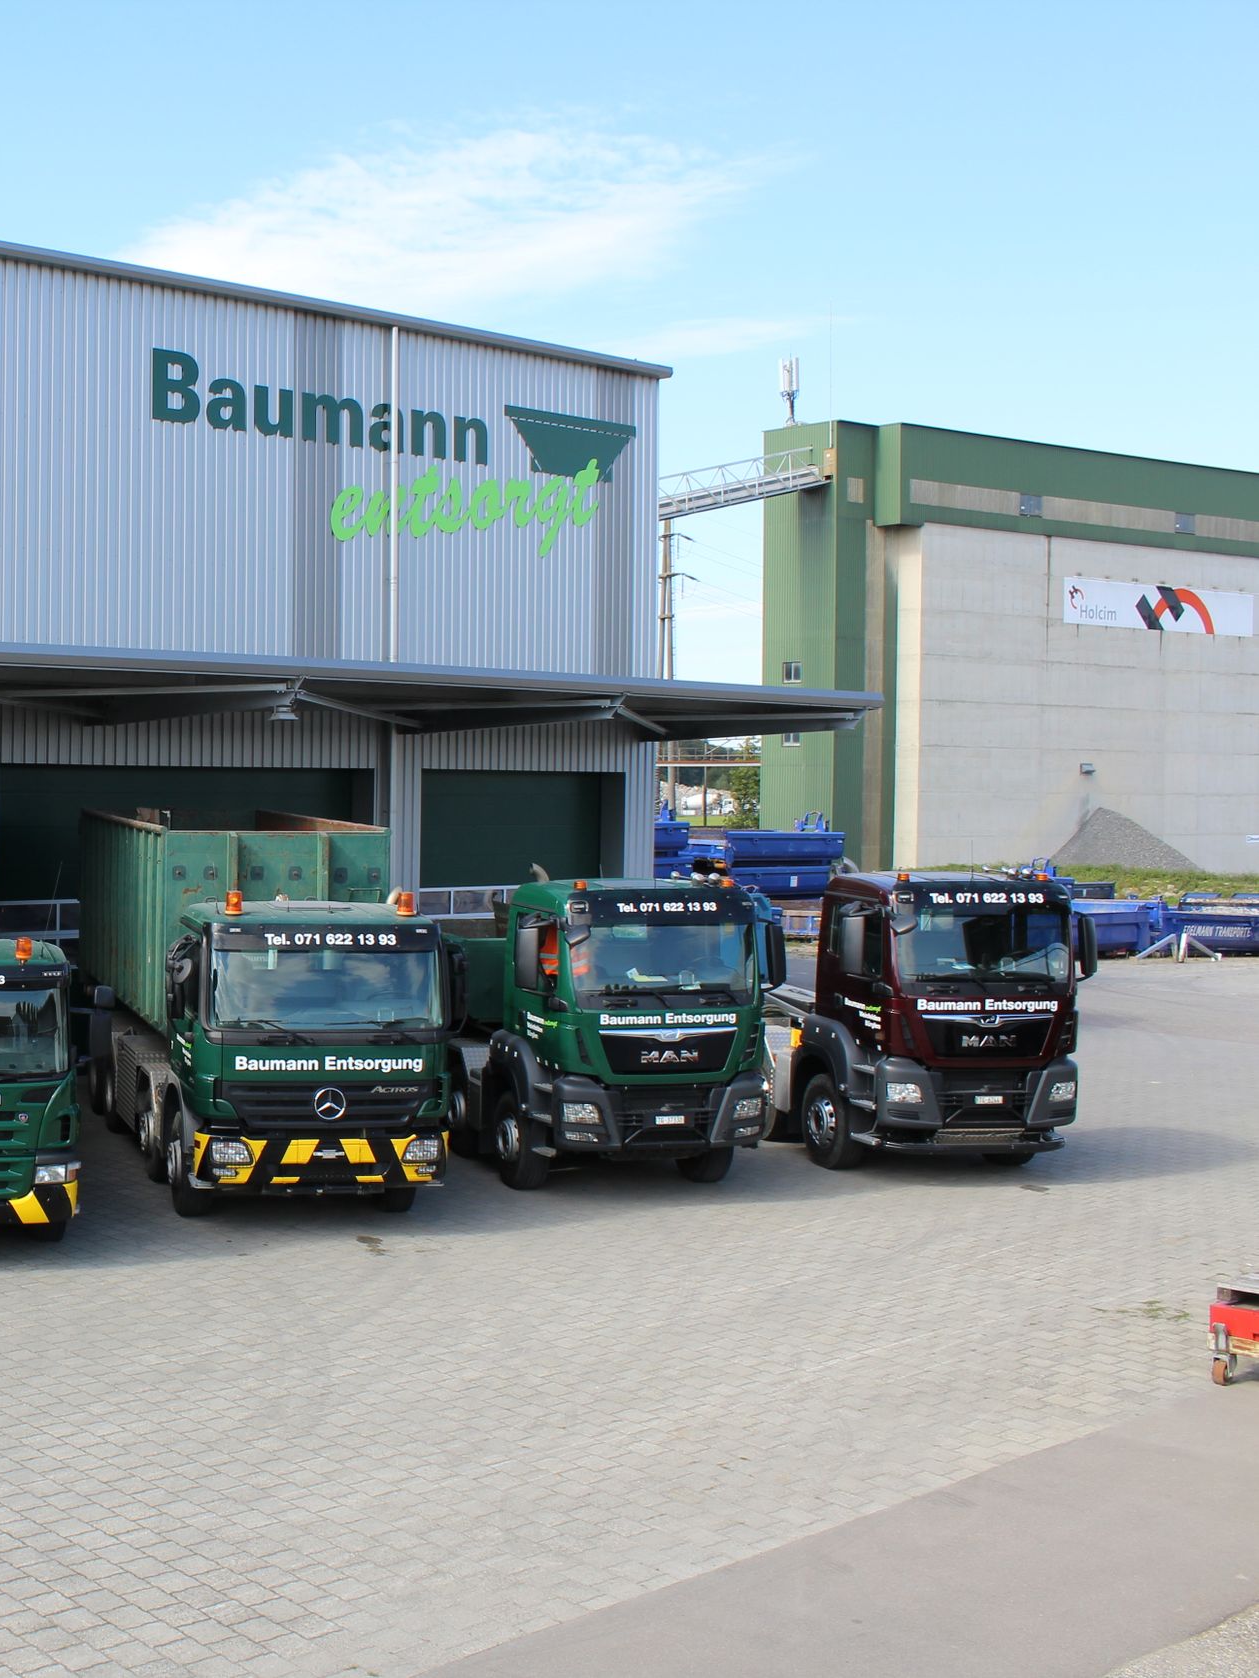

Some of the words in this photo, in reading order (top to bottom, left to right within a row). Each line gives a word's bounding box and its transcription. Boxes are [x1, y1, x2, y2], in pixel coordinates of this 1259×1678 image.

[151, 347, 488, 466] Baumann
[329, 458, 600, 558] entsorgt
[1079, 604, 1117, 621] Holcim
[929, 893, 953, 904] Tel.
[956, 893, 979, 904] 071
[983, 893, 1007, 904] 622
[1010, 893, 1026, 904] 13
[1028, 893, 1044, 904] 93
[617, 902, 638, 912] Tel.
[639, 902, 660, 912] 071
[663, 902, 685, 912] 622
[687, 902, 701, 912] 13
[702, 902, 717, 912] 93
[264, 933, 291, 945] Tel.
[294, 933, 321, 945] 071
[325, 933, 353, 945] 622
[357, 933, 375, 945] 13
[378, 933, 397, 945] 93
[917, 999, 981, 1011] Baumann
[985, 999, 1058, 1013] Entsorgung
[599, 1014, 661, 1025] Baumann
[665, 1013, 737, 1025] Entsorgung
[962, 1035, 1017, 1047] MAN
[641, 1050, 699, 1063] MAN
[235, 1056, 319, 1071] Baumann
[324, 1056, 423, 1073] Entsorgung
